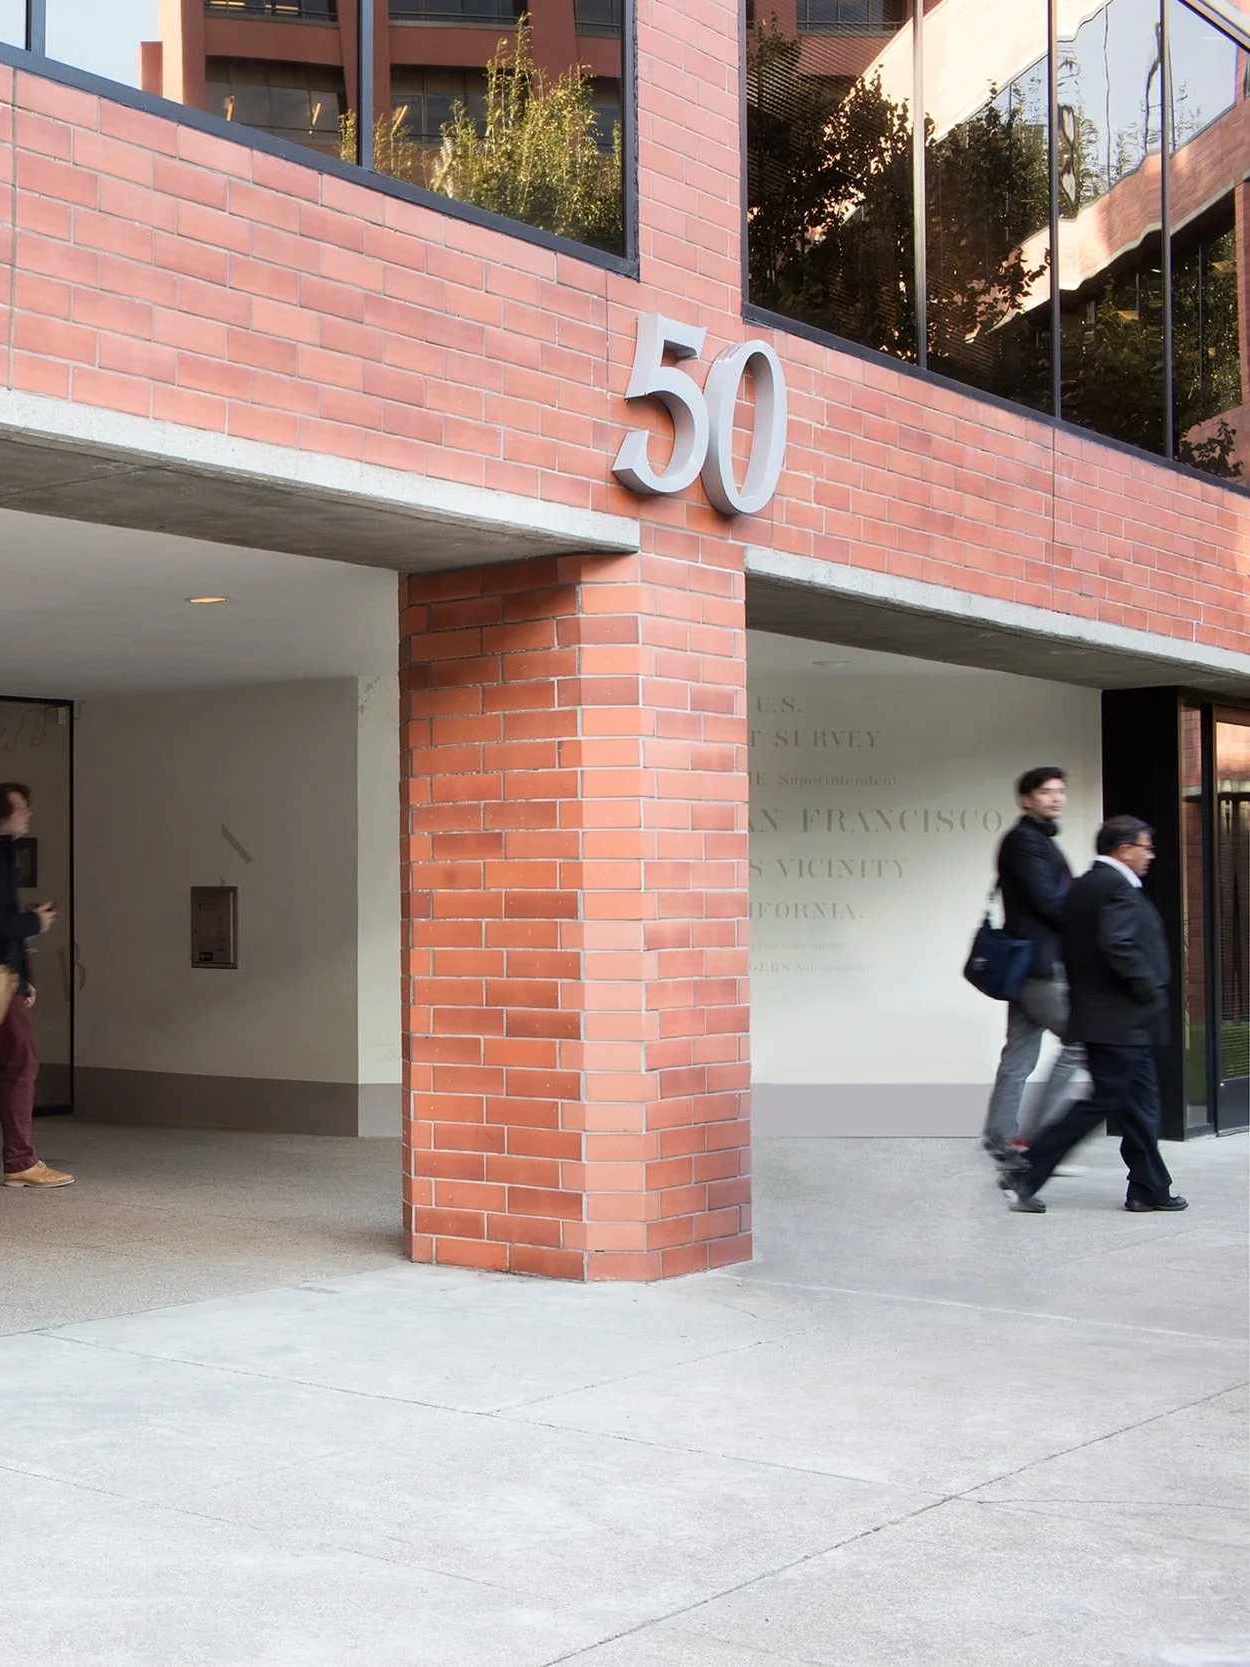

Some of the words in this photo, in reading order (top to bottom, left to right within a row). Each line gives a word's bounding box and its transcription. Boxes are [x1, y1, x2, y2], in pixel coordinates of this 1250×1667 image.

[612, 313, 787, 515] 50
[757, 696, 802, 713] U.S.
[774, 730, 880, 748] SURVEY
[801, 808, 1002, 833] FRANCISCO
[777, 858, 908, 878] VICINITY
